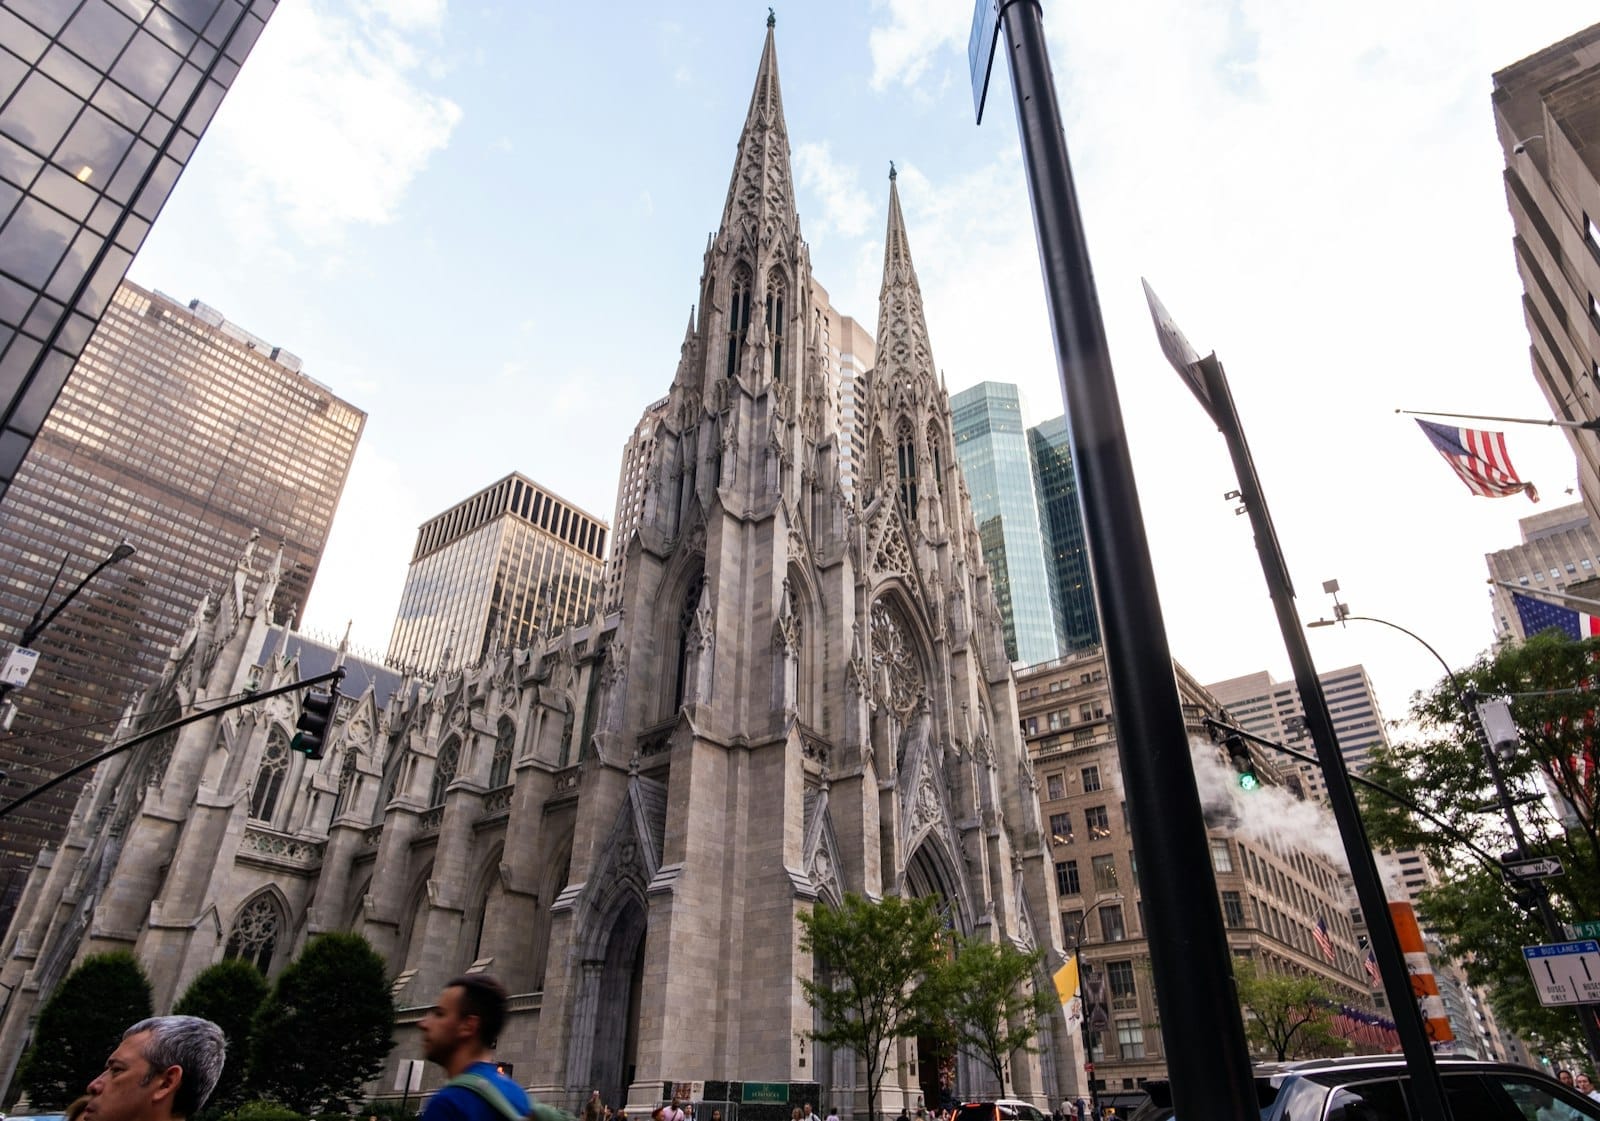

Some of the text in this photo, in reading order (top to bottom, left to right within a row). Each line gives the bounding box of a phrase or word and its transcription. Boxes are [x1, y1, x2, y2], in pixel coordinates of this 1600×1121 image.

[1534, 862, 1553, 872] WAY
[1585, 923, 1597, 937] 51
[1540, 944, 1580, 956] BUS LANES
[1547, 984, 1566, 993] BUSES
[1551, 993, 1567, 1002] ONLY
